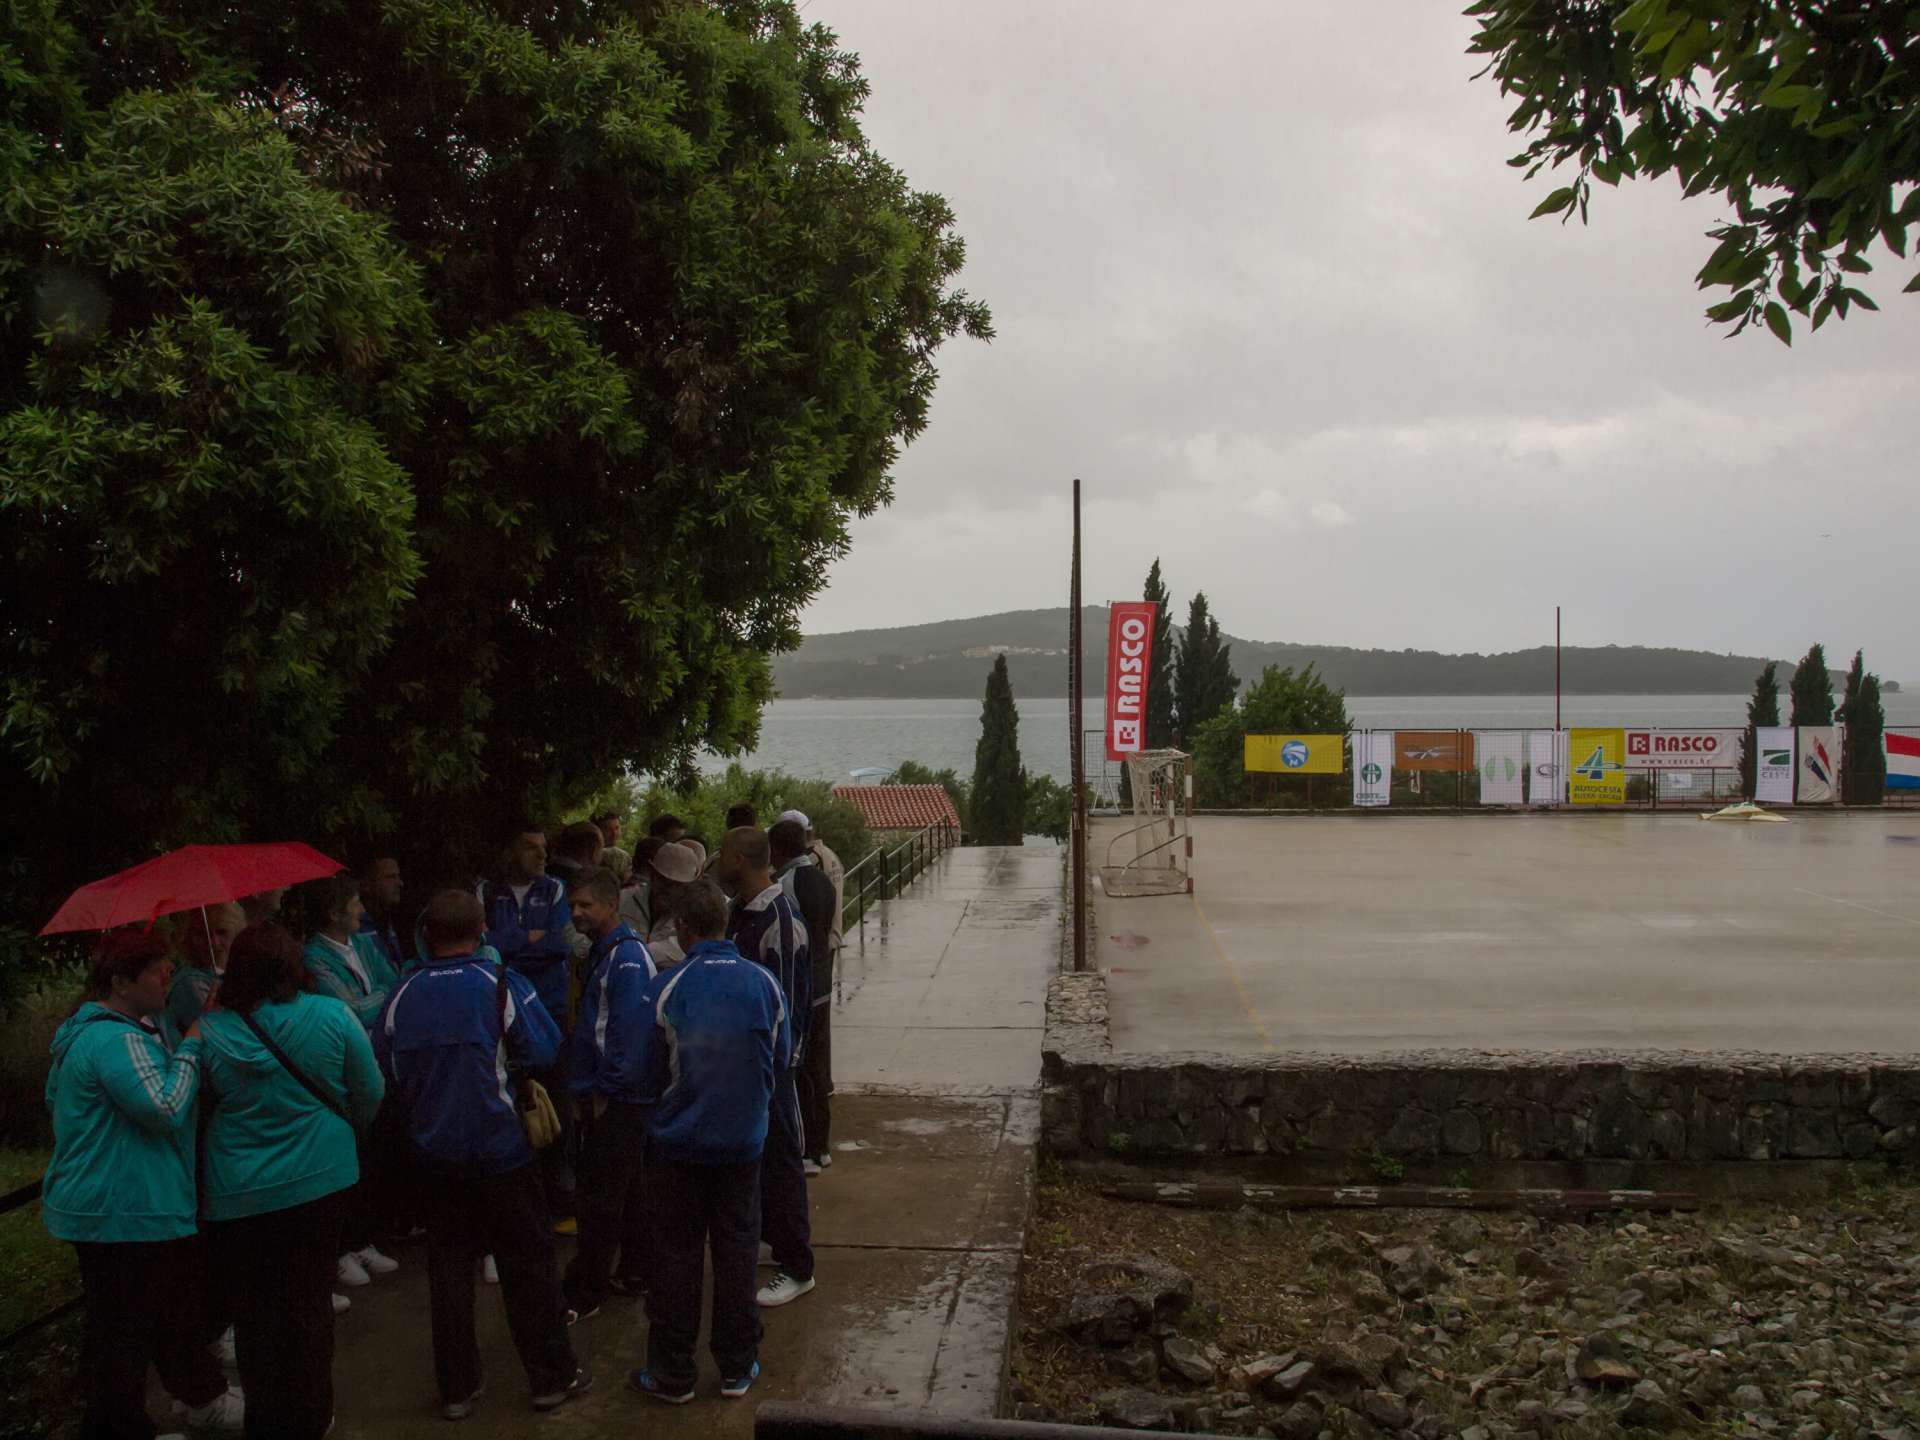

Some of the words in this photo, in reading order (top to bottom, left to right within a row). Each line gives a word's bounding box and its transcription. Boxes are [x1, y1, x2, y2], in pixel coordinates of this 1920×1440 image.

[1118, 619, 1145, 713] RASCO
[1655, 736, 1717, 752] RASCO
[1574, 785, 1622, 793] AUTOCESTA
